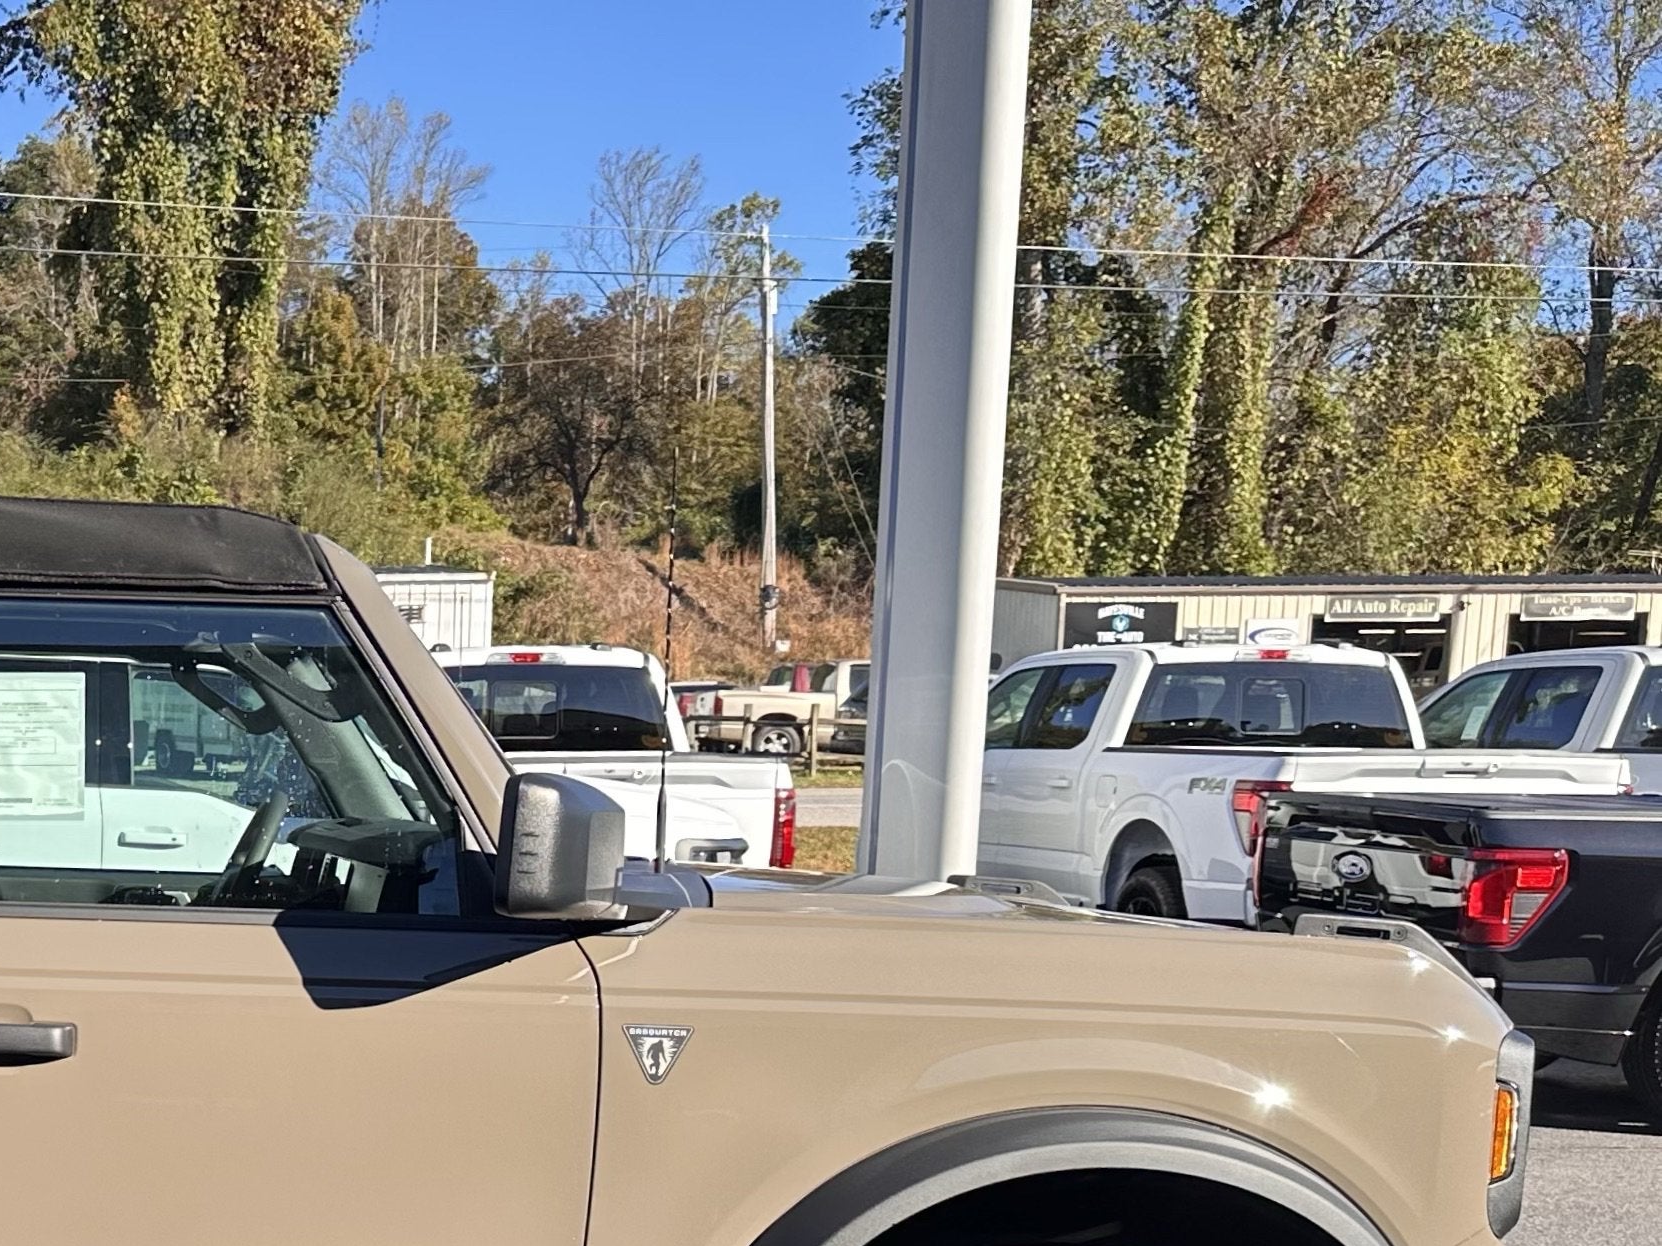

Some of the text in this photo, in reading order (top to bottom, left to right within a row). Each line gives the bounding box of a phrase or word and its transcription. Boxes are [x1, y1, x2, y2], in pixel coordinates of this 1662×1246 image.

[1330, 598, 1436, 617] All Auto Repair
[1188, 777, 1227, 795] FX4
[629, 1027, 687, 1037] SASQUATCH
